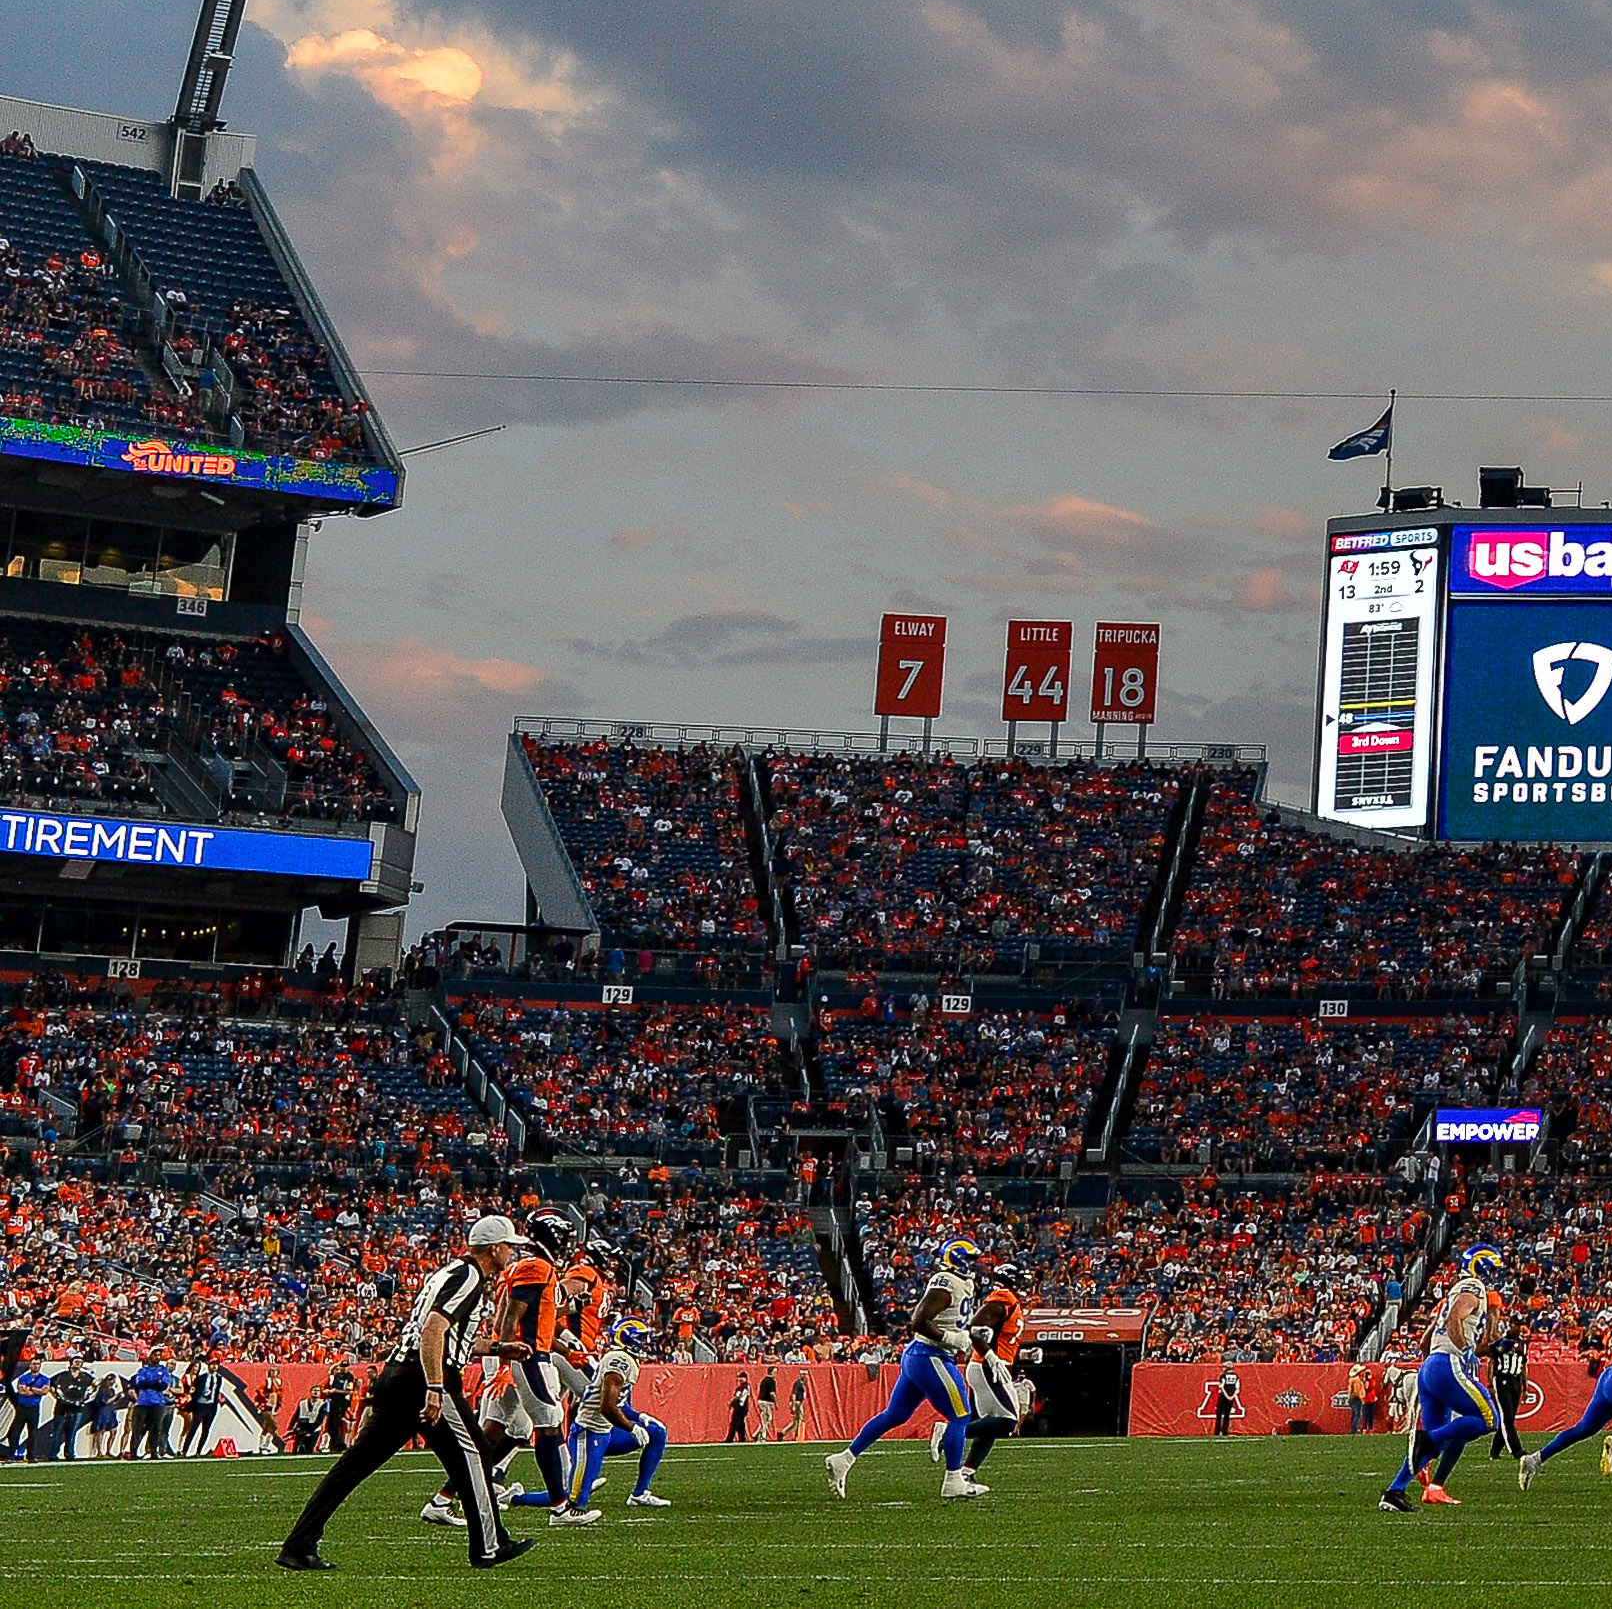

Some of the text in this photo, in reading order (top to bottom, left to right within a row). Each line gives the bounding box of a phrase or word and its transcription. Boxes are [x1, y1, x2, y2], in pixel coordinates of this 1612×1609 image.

[122, 126, 146, 141] 542
[148, 455, 234, 475] UNITED
[1336, 532, 1433, 549] BETFRED SPORTS
[1368, 561, 1401, 576] 1:59
[1338, 585, 1356, 599] 13
[1374, 585, 1392, 594] 2nd
[1414, 579, 1424, 593] 2
[180, 600, 205, 615] 346
[894, 621, 935, 637] ELWAY
[1020, 627, 1058, 641] LITTLE
[1098, 629, 1156, 643] TRIPUCKA
[898, 661, 924, 700] 7
[1008, 665, 1063, 705] 44
[1104, 667, 1144, 707] 18
[1092, 711, 1134, 721] MANNING
[620, 727, 643, 738] 228
[1352, 736, 1400, 747] 3rd Down
[1019, 745, 1041, 755] 229
[1210, 748, 1231, 758] 230
[1352, 795, 1394, 805] TEXANS
[0, 815, 214, 865] TIREMENT
[112, 962, 138, 977] 128
[606, 988, 630, 1002] 129
[945, 997, 970, 1011] 129
[1322, 1003, 1346, 1015] 130
[1437, 1123, 1540, 1141] EMPOWER
[1037, 1331, 1084, 1341] GEICO
